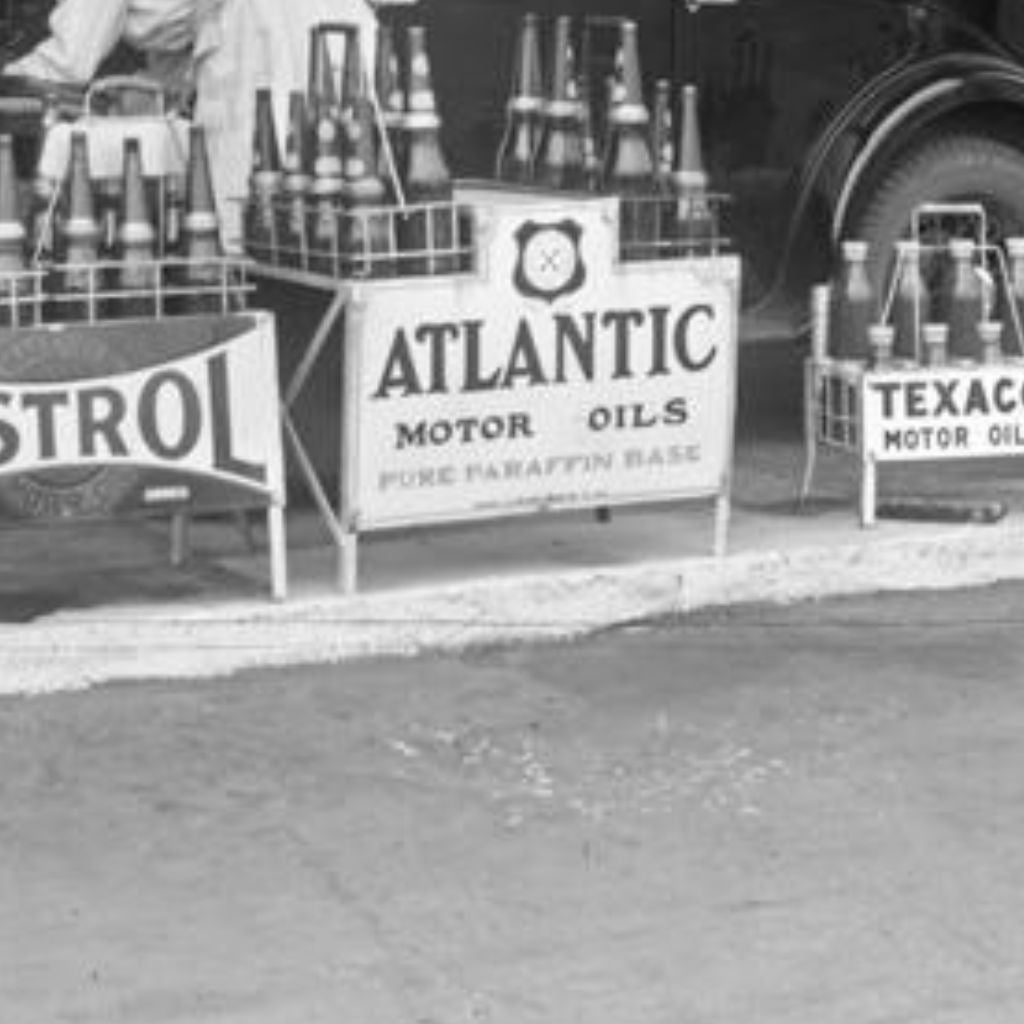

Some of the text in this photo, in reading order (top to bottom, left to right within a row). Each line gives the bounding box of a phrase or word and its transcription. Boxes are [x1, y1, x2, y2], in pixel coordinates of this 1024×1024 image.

[372, 304, 718, 400] ATLANTIC
[871, 377, 1024, 417] TEXAC
[394, 396, 689, 450] MOTOR OILS
[884, 426, 968, 451] MOTOR
[378, 443, 702, 492] PURE PARAFFIN BASE
